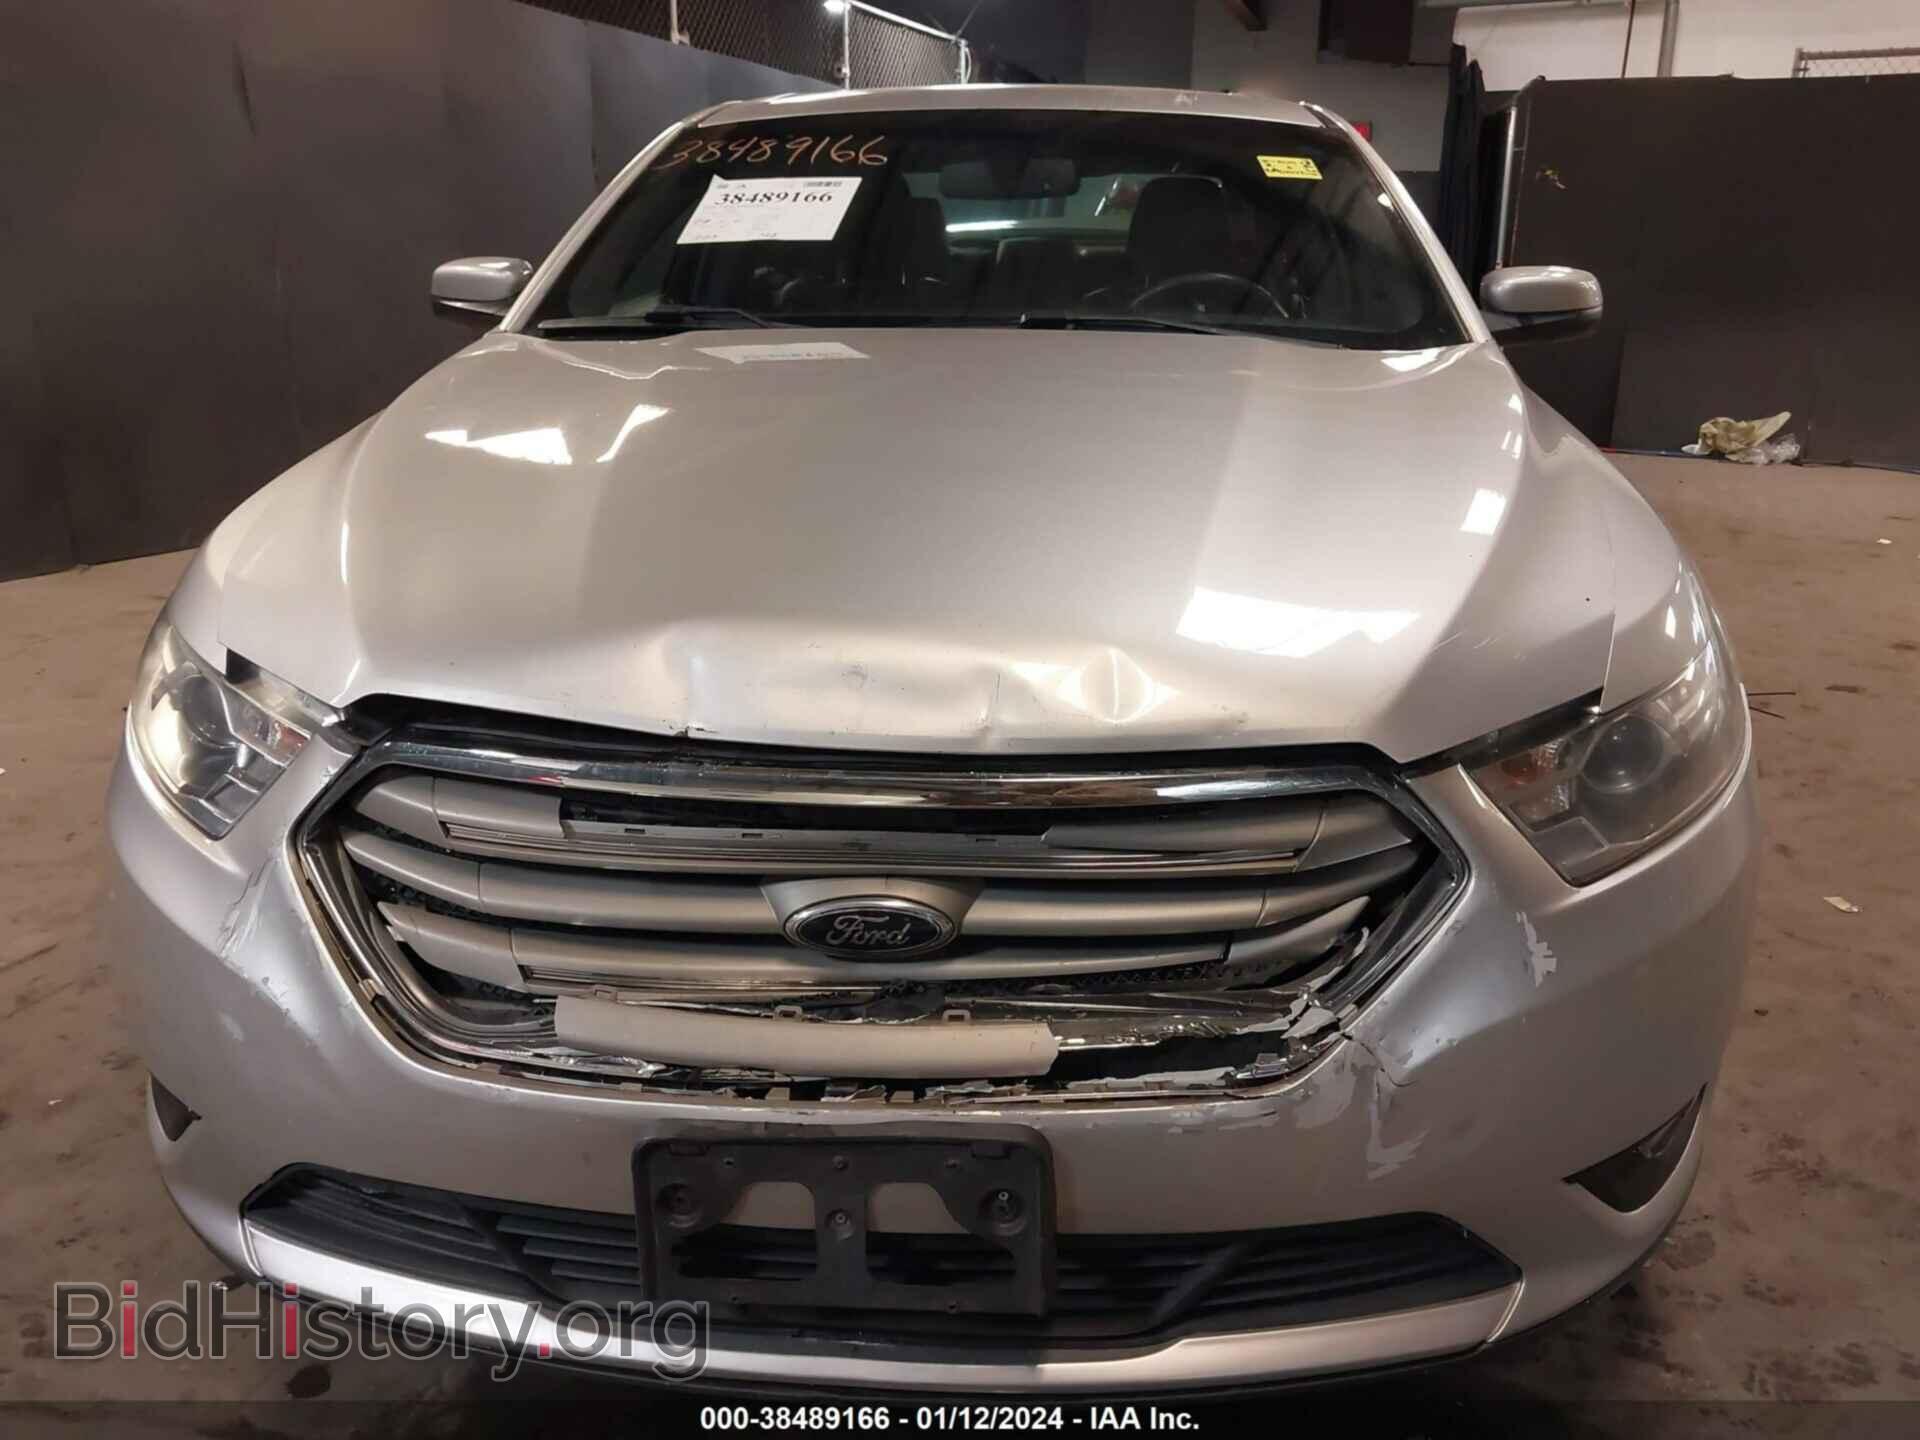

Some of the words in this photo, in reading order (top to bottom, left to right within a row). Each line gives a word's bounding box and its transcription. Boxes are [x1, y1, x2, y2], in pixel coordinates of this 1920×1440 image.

[655, 135, 888, 169] 38489166
[714, 191, 834, 206] 38489166
[826, 914, 912, 945] Ford
